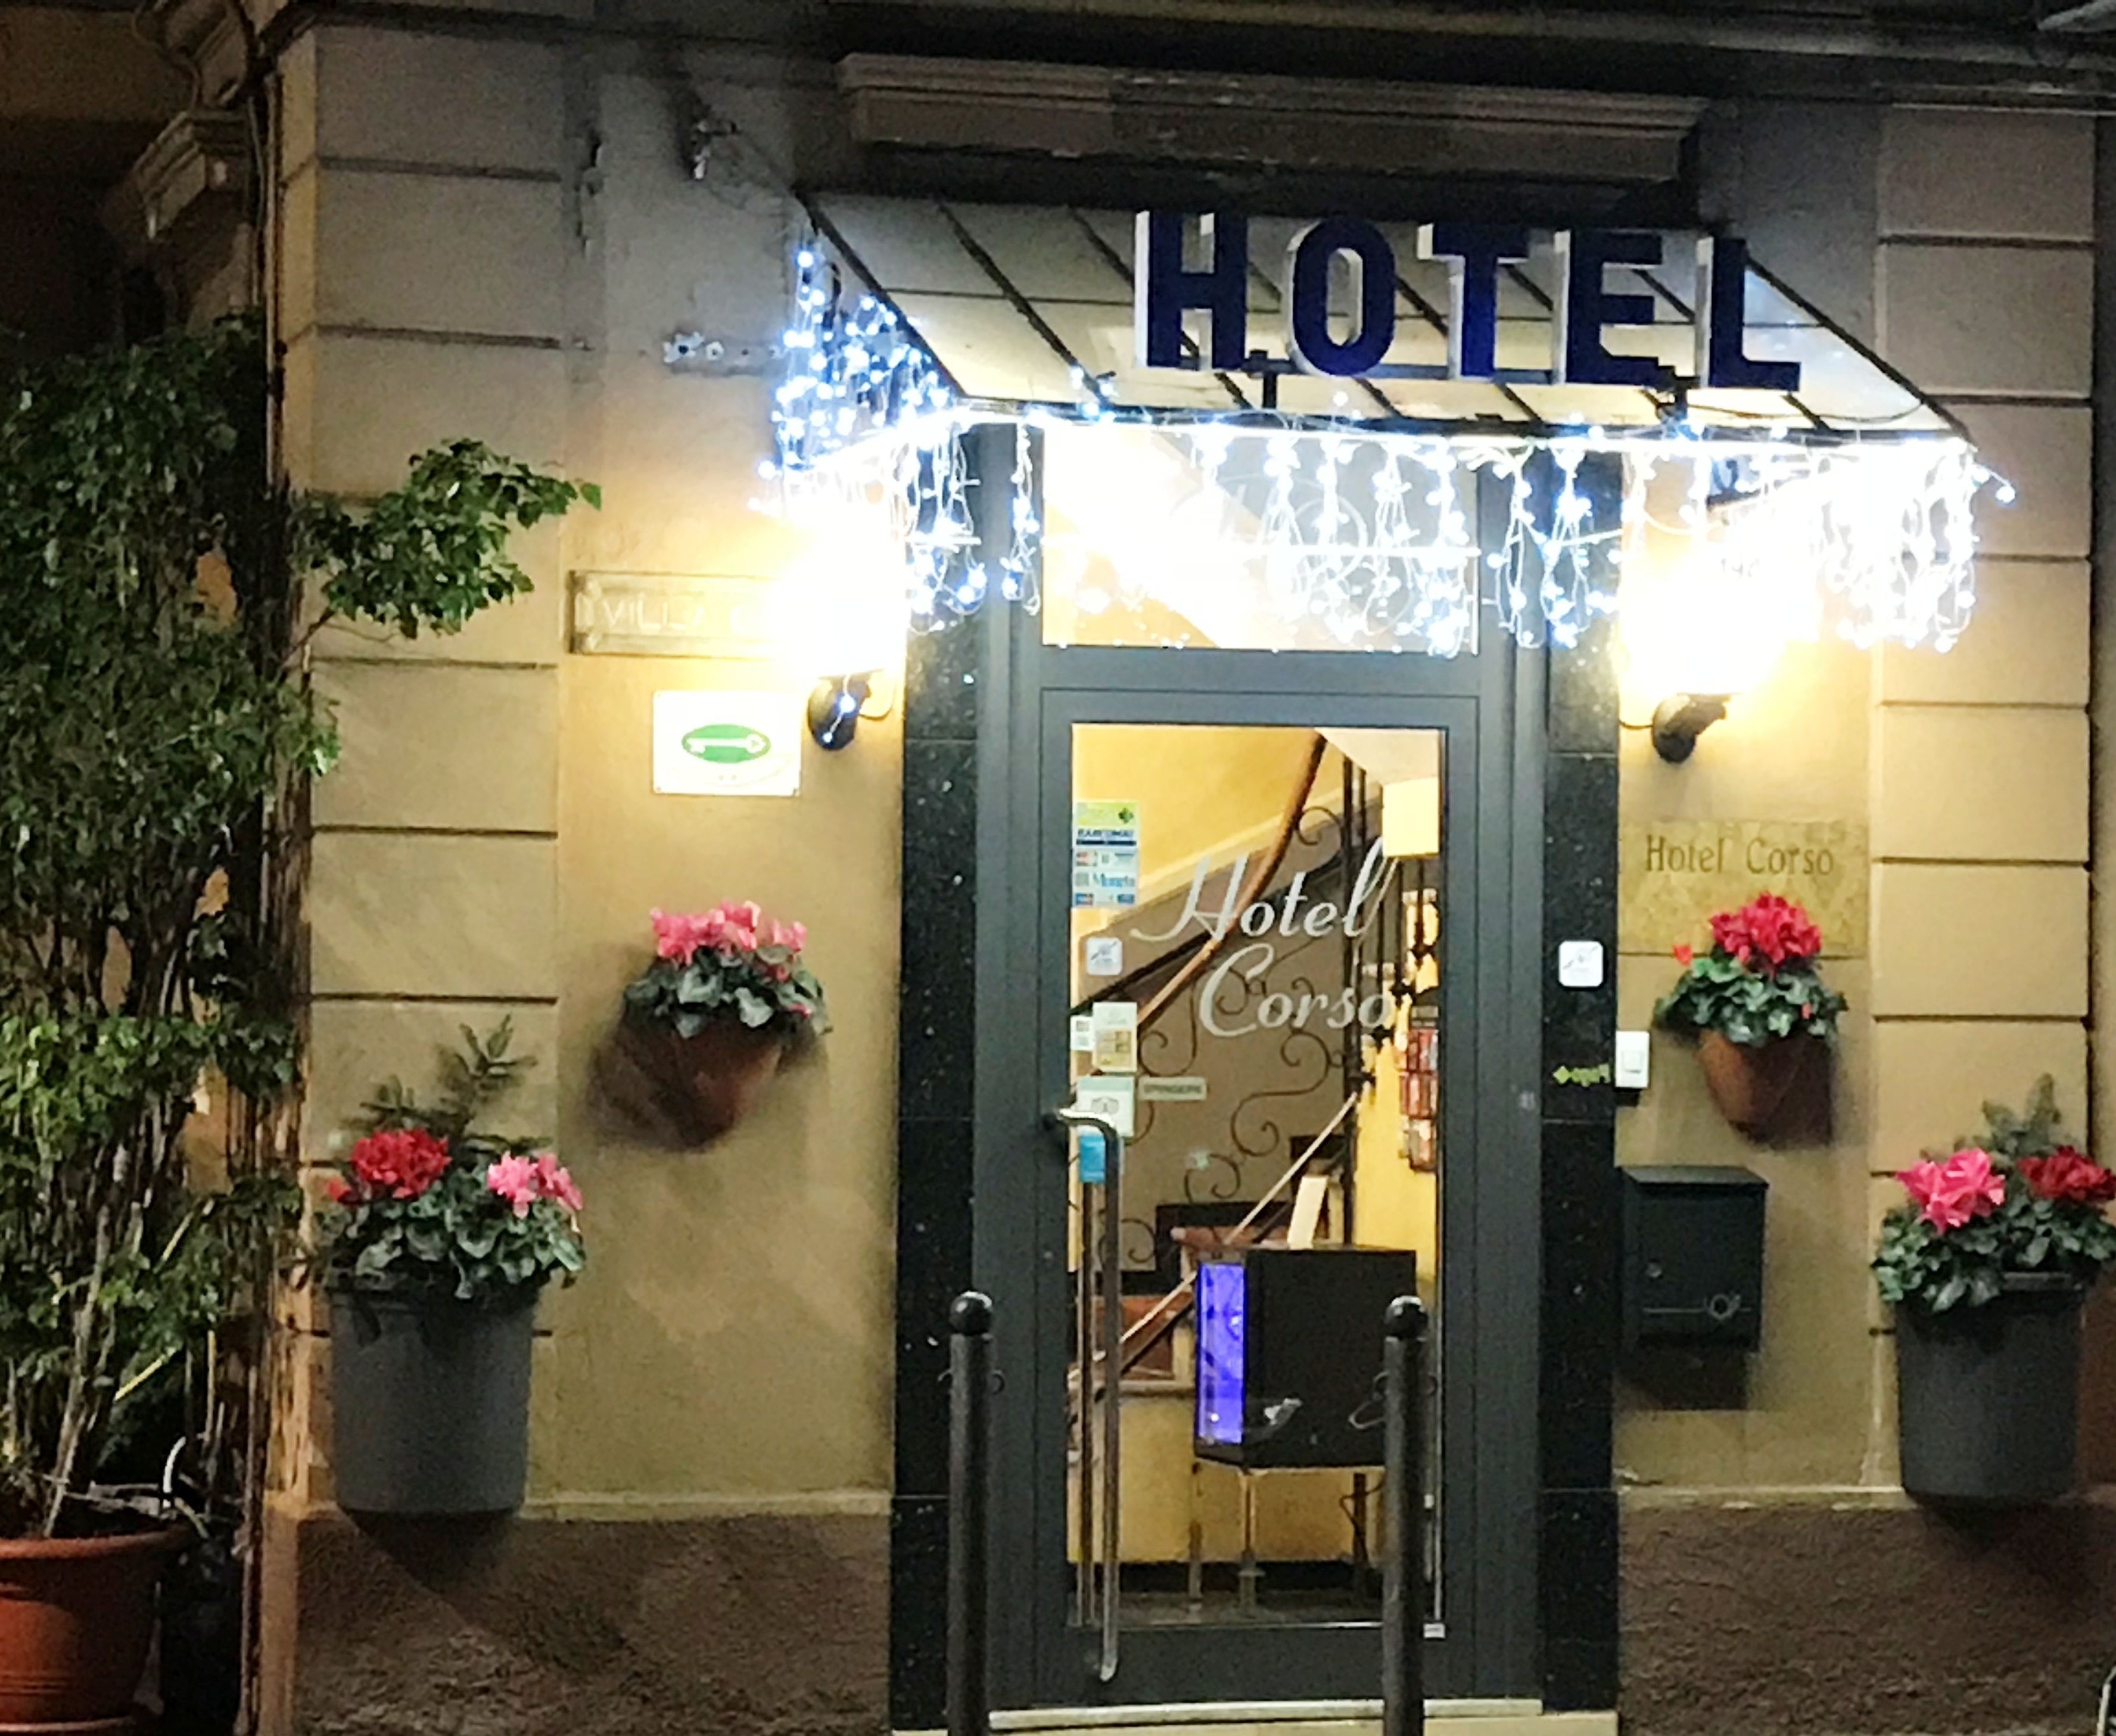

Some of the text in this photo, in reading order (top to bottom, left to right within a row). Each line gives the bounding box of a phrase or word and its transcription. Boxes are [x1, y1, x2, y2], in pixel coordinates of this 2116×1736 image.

[1135, 211, 1800, 390] HOTEL
[1131, 839, 1398, 941] Hotel
[1646, 835, 1834, 876] Hotel Corso
[1200, 944, 1392, 1036] Corso
